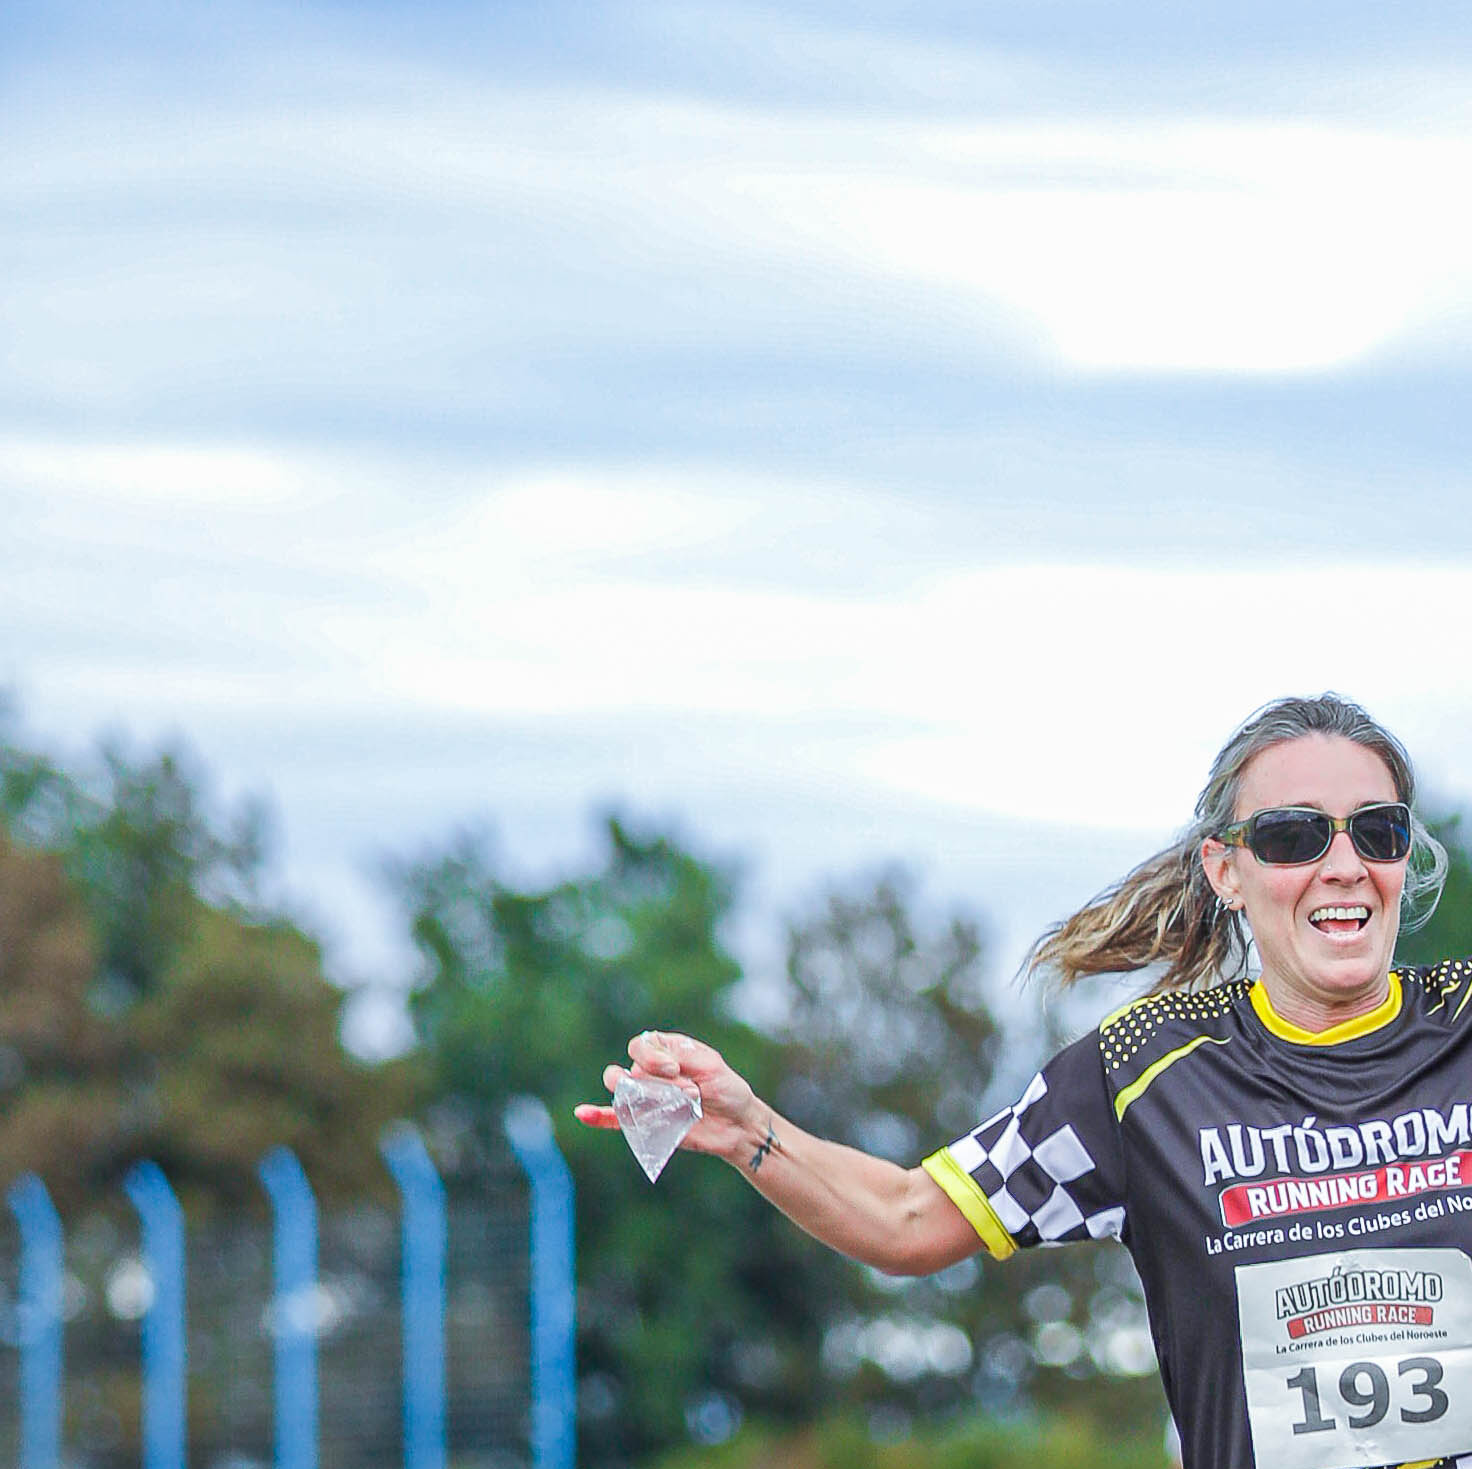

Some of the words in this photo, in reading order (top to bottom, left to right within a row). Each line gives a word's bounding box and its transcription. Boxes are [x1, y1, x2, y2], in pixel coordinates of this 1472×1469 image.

[1246, 1174, 1378, 1218] RUNNING
[1386, 1156, 1463, 1197] RACE
[1205, 1236, 1222, 1255] La
[1223, 1227, 1285, 1251] Carrera
[1288, 1222, 1313, 1241] de
[1317, 1221, 1345, 1239] los
[1347, 1210, 1412, 1236] Clubes
[1414, 1199, 1445, 1221] del
[1275, 1266, 1444, 1320] AUTÓDROMO
[1303, 1306, 1373, 1334] RUNNING
[1376, 1305, 1417, 1324] RACE
[1275, 1344, 1288, 1355] La
[1288, 1339, 1324, 1352] Carrera
[1325, 1336, 1339, 1347] de
[1340, 1333, 1355, 1345] los
[1356, 1331, 1389, 1344] Clubes
[1390, 1329, 1405, 1341] del
[1406, 1329, 1449, 1341] Noroeste
[1286, 1357, 1450, 1436] 193
